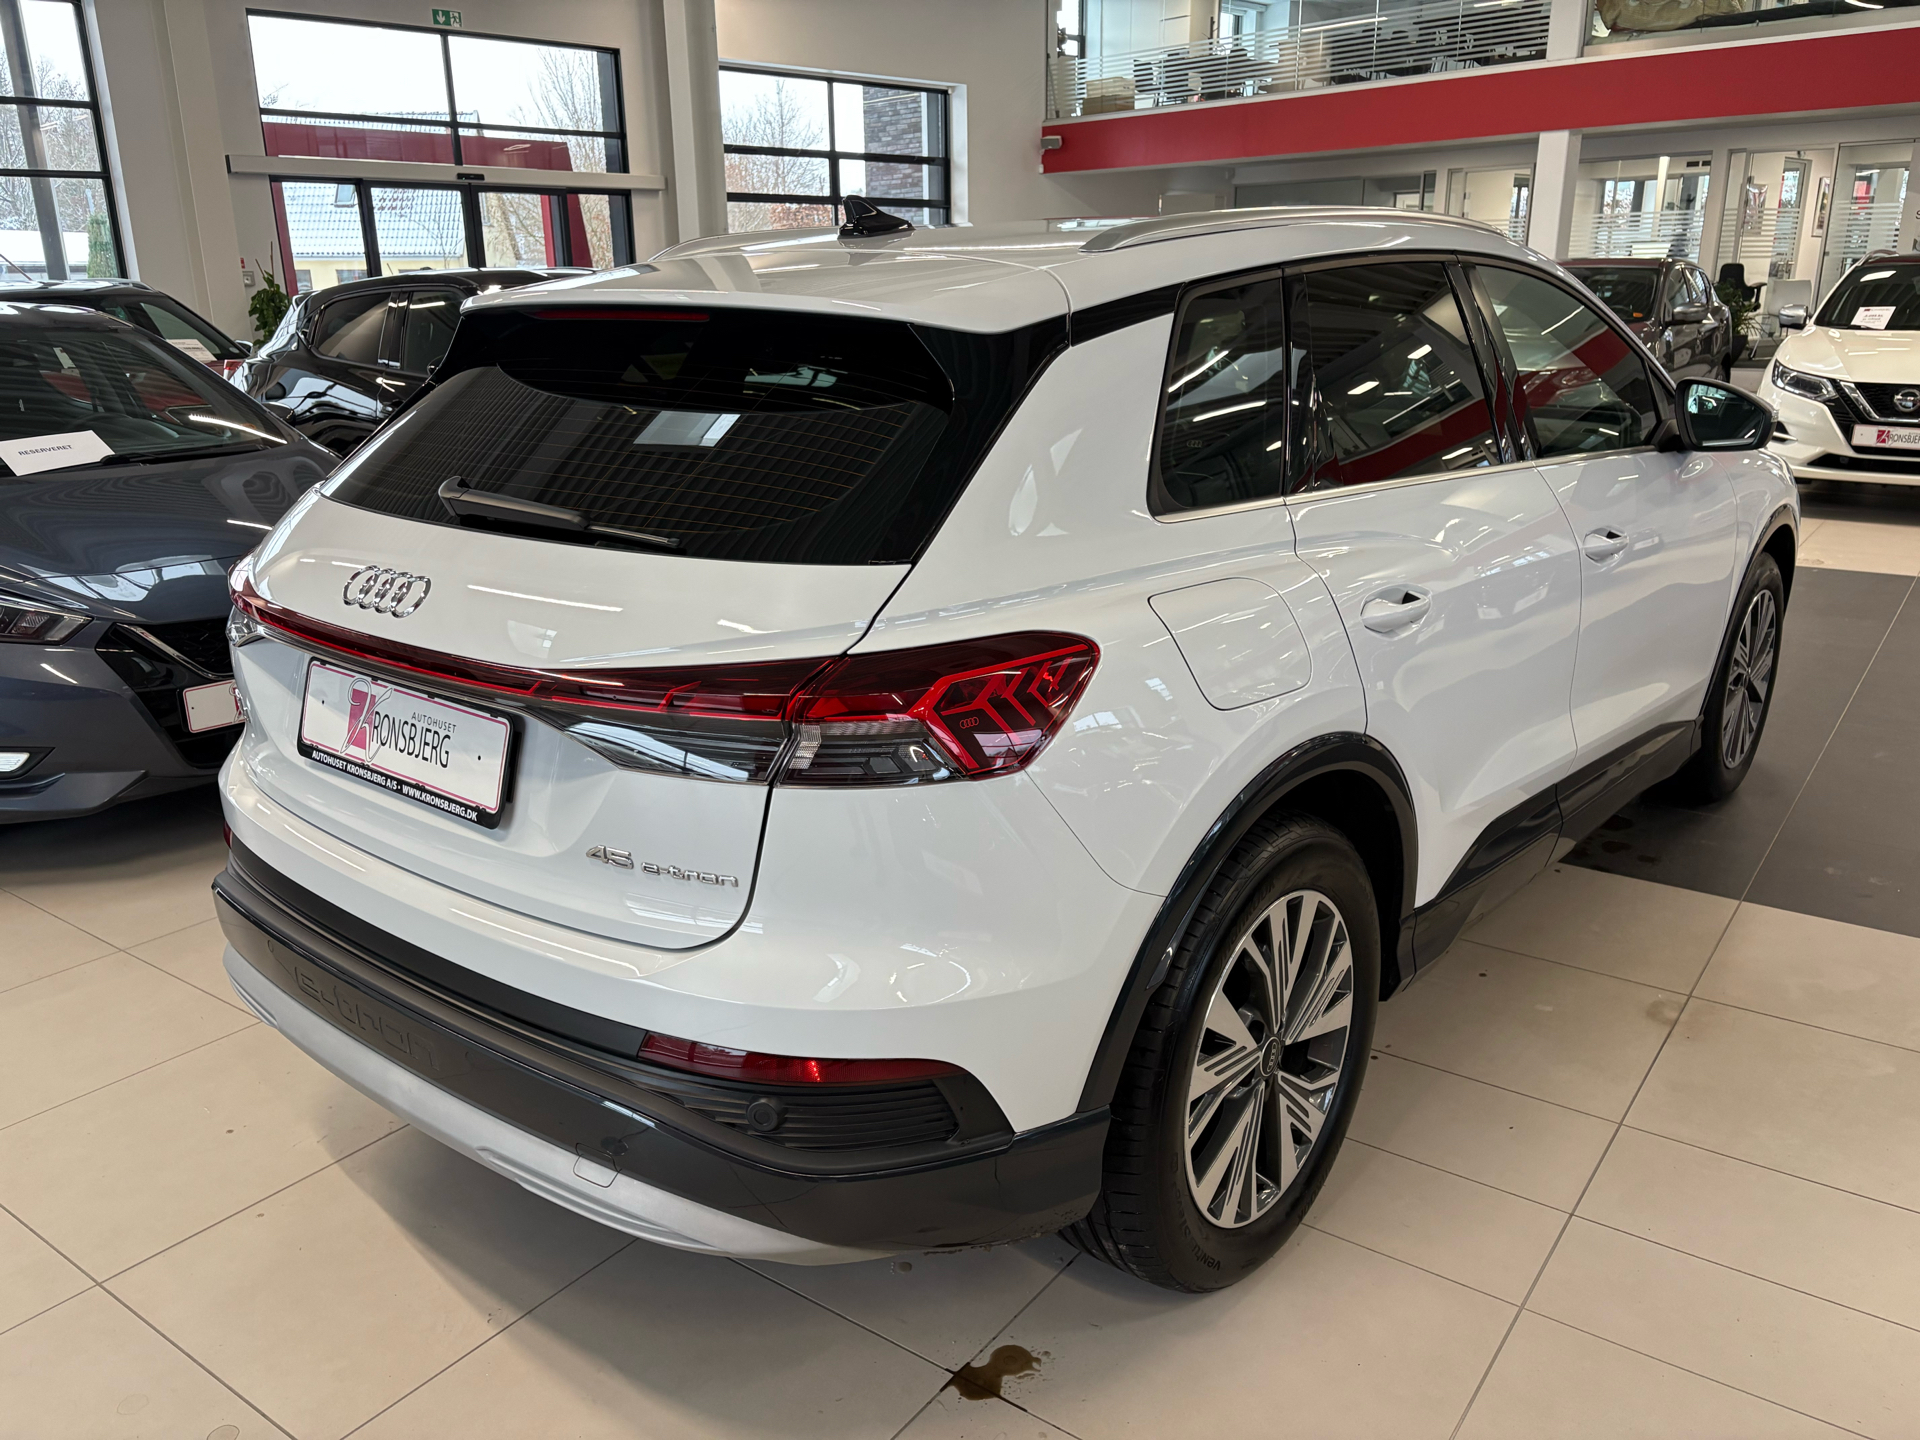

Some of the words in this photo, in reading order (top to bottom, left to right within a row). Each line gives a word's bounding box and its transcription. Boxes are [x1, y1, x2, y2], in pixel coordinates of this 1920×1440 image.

[18, 444, 73, 456] RESERVERET
[411, 711, 457, 734] AUTOHUSET
[311, 750, 347, 771] AUTOHUSET
[346, 763, 386, 786] KRONSBJERG
[385, 776, 398, 790] A/S
[402, 784, 478, 822] WWW.KRONSBJERG.DK
[585, 844, 635, 870] 45
[641, 861, 739, 888] e-tron
[294, 965, 440, 1072] e-tron
